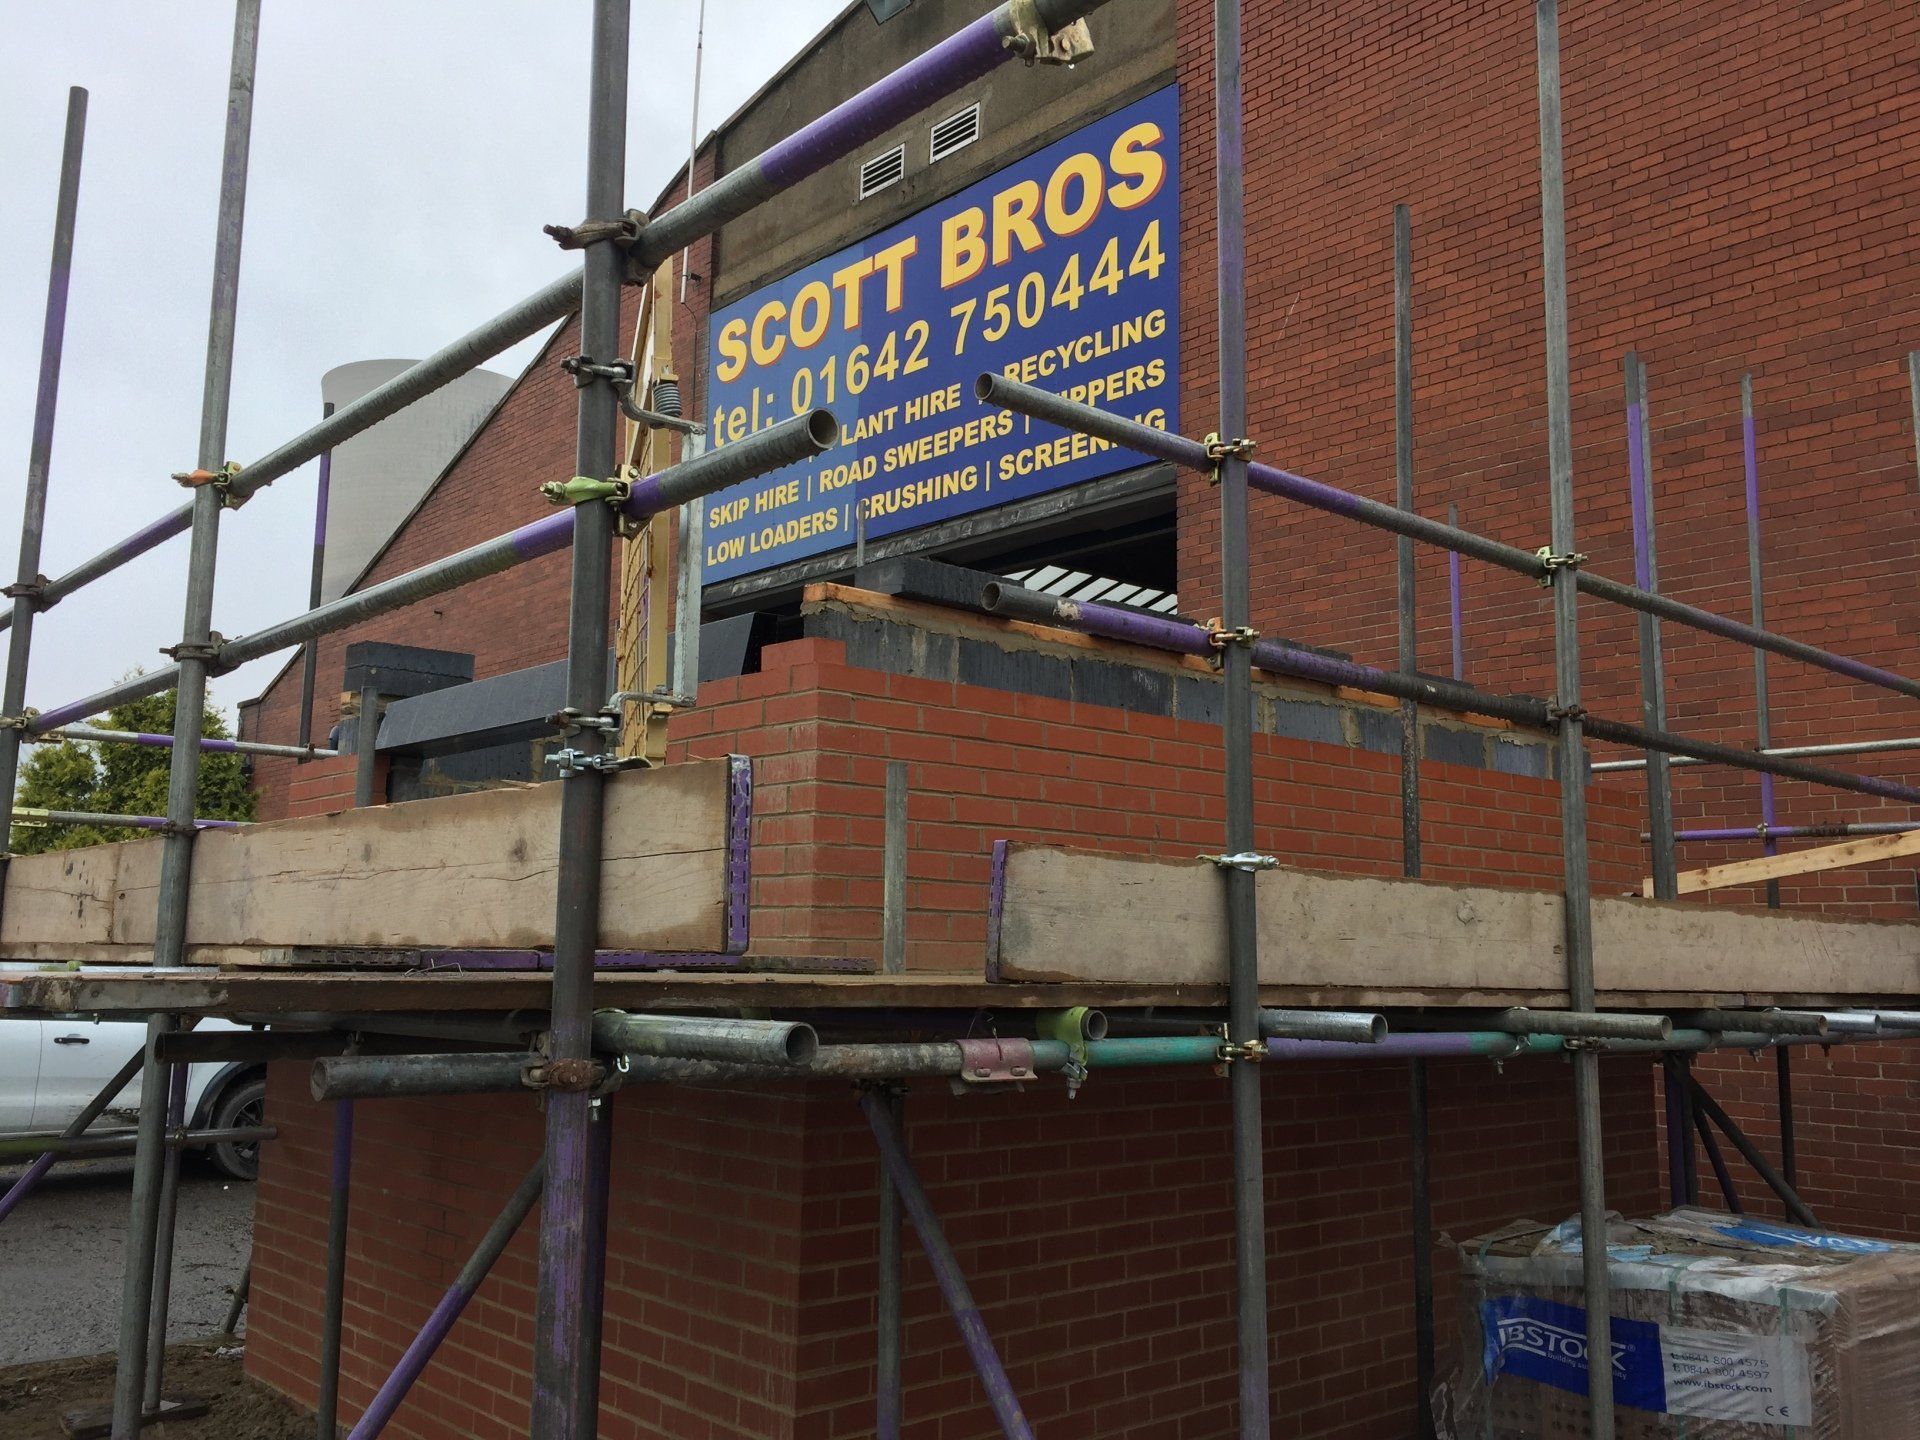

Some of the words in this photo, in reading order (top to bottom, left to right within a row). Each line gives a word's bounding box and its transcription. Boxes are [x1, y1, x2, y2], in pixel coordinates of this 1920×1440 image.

[716, 235, 917, 383] SCOTT
[940, 122, 1167, 290] BROS
[713, 387, 774, 448] tel:
[792, 319, 930, 415] 01642
[950, 219, 1166, 356] 750444
[830, 406, 898, 449] LANT
[905, 383, 962, 424] HIRE
[1003, 309, 1166, 384] RECYCLING
[707, 536, 745, 567] LOW
[750, 507, 838, 554] LOADERS
[856, 465, 978, 521] CRUSHING
[709, 497, 750, 529] SKIP
[755, 480, 800, 515] HIRE
[819, 455, 877, 493] ROAD
[883, 409, 1014, 472] SWEEPERS
[1056, 358, 1166, 408] PPERS
[1498, 1325, 1626, 1371] IBSTOK
